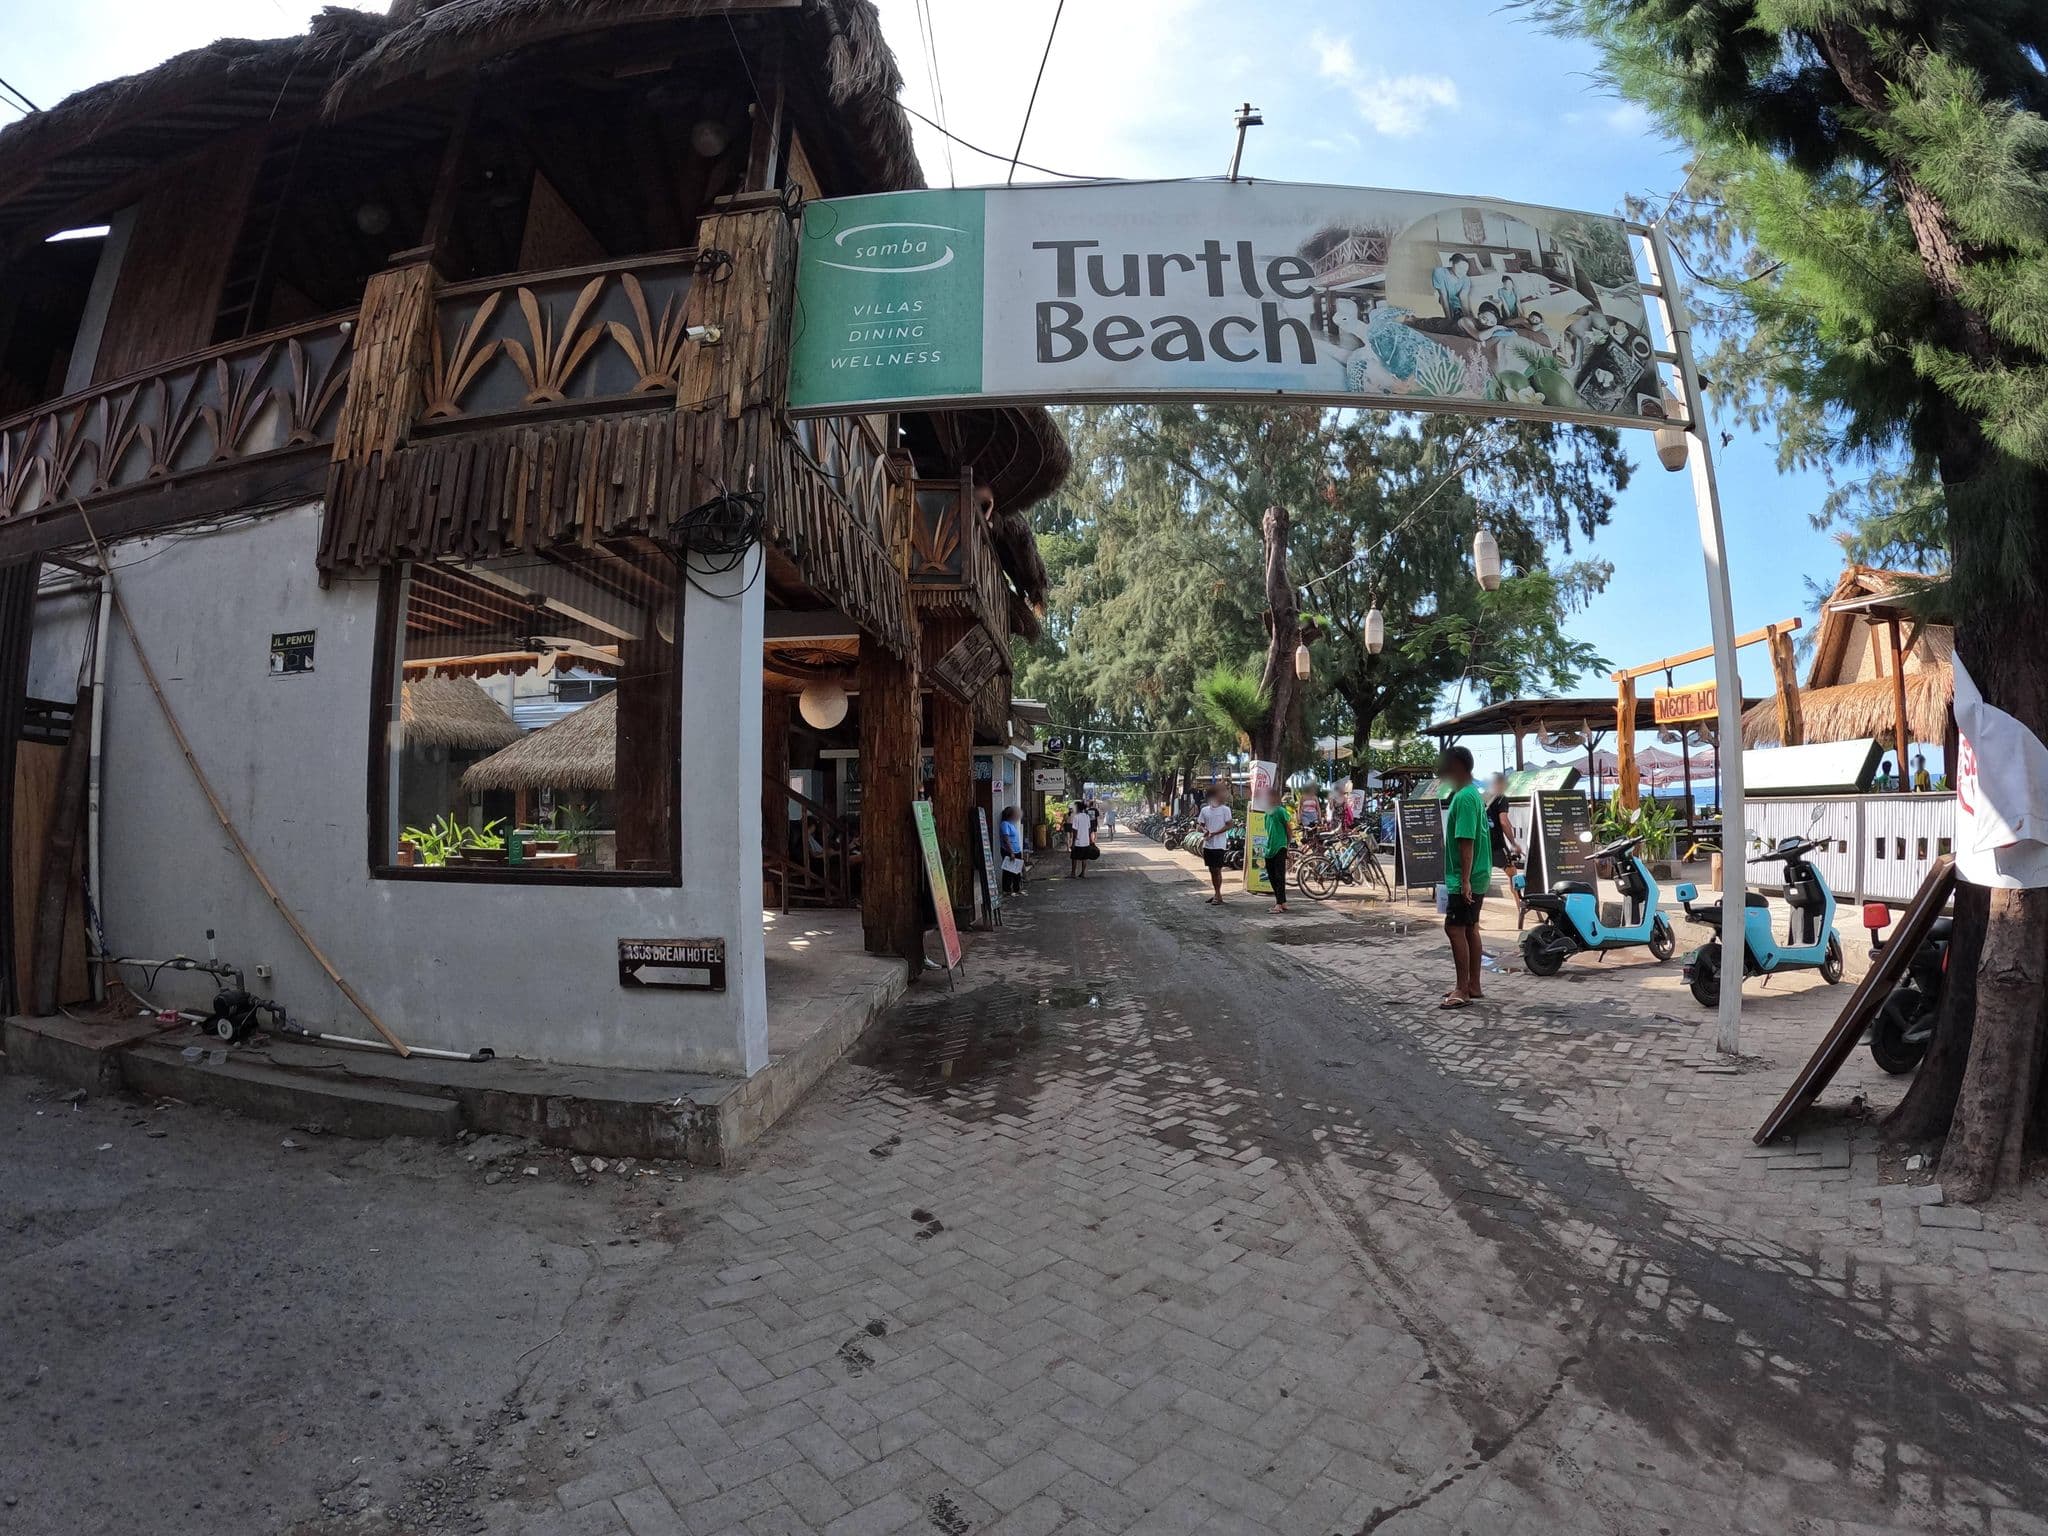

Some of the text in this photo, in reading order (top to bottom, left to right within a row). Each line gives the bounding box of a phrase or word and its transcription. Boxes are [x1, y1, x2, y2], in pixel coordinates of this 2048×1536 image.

[856, 239, 928, 258] samba
[1032, 239, 1316, 299] Turtle
[853, 300, 923, 316] VILLAS
[849, 326, 924, 342] DINING
[1036, 301, 1317, 364] Beach
[831, 351, 942, 369] WELLNESS
[286, 634, 314, 646] PENYU
[687, 948, 721, 963] HOTEL
